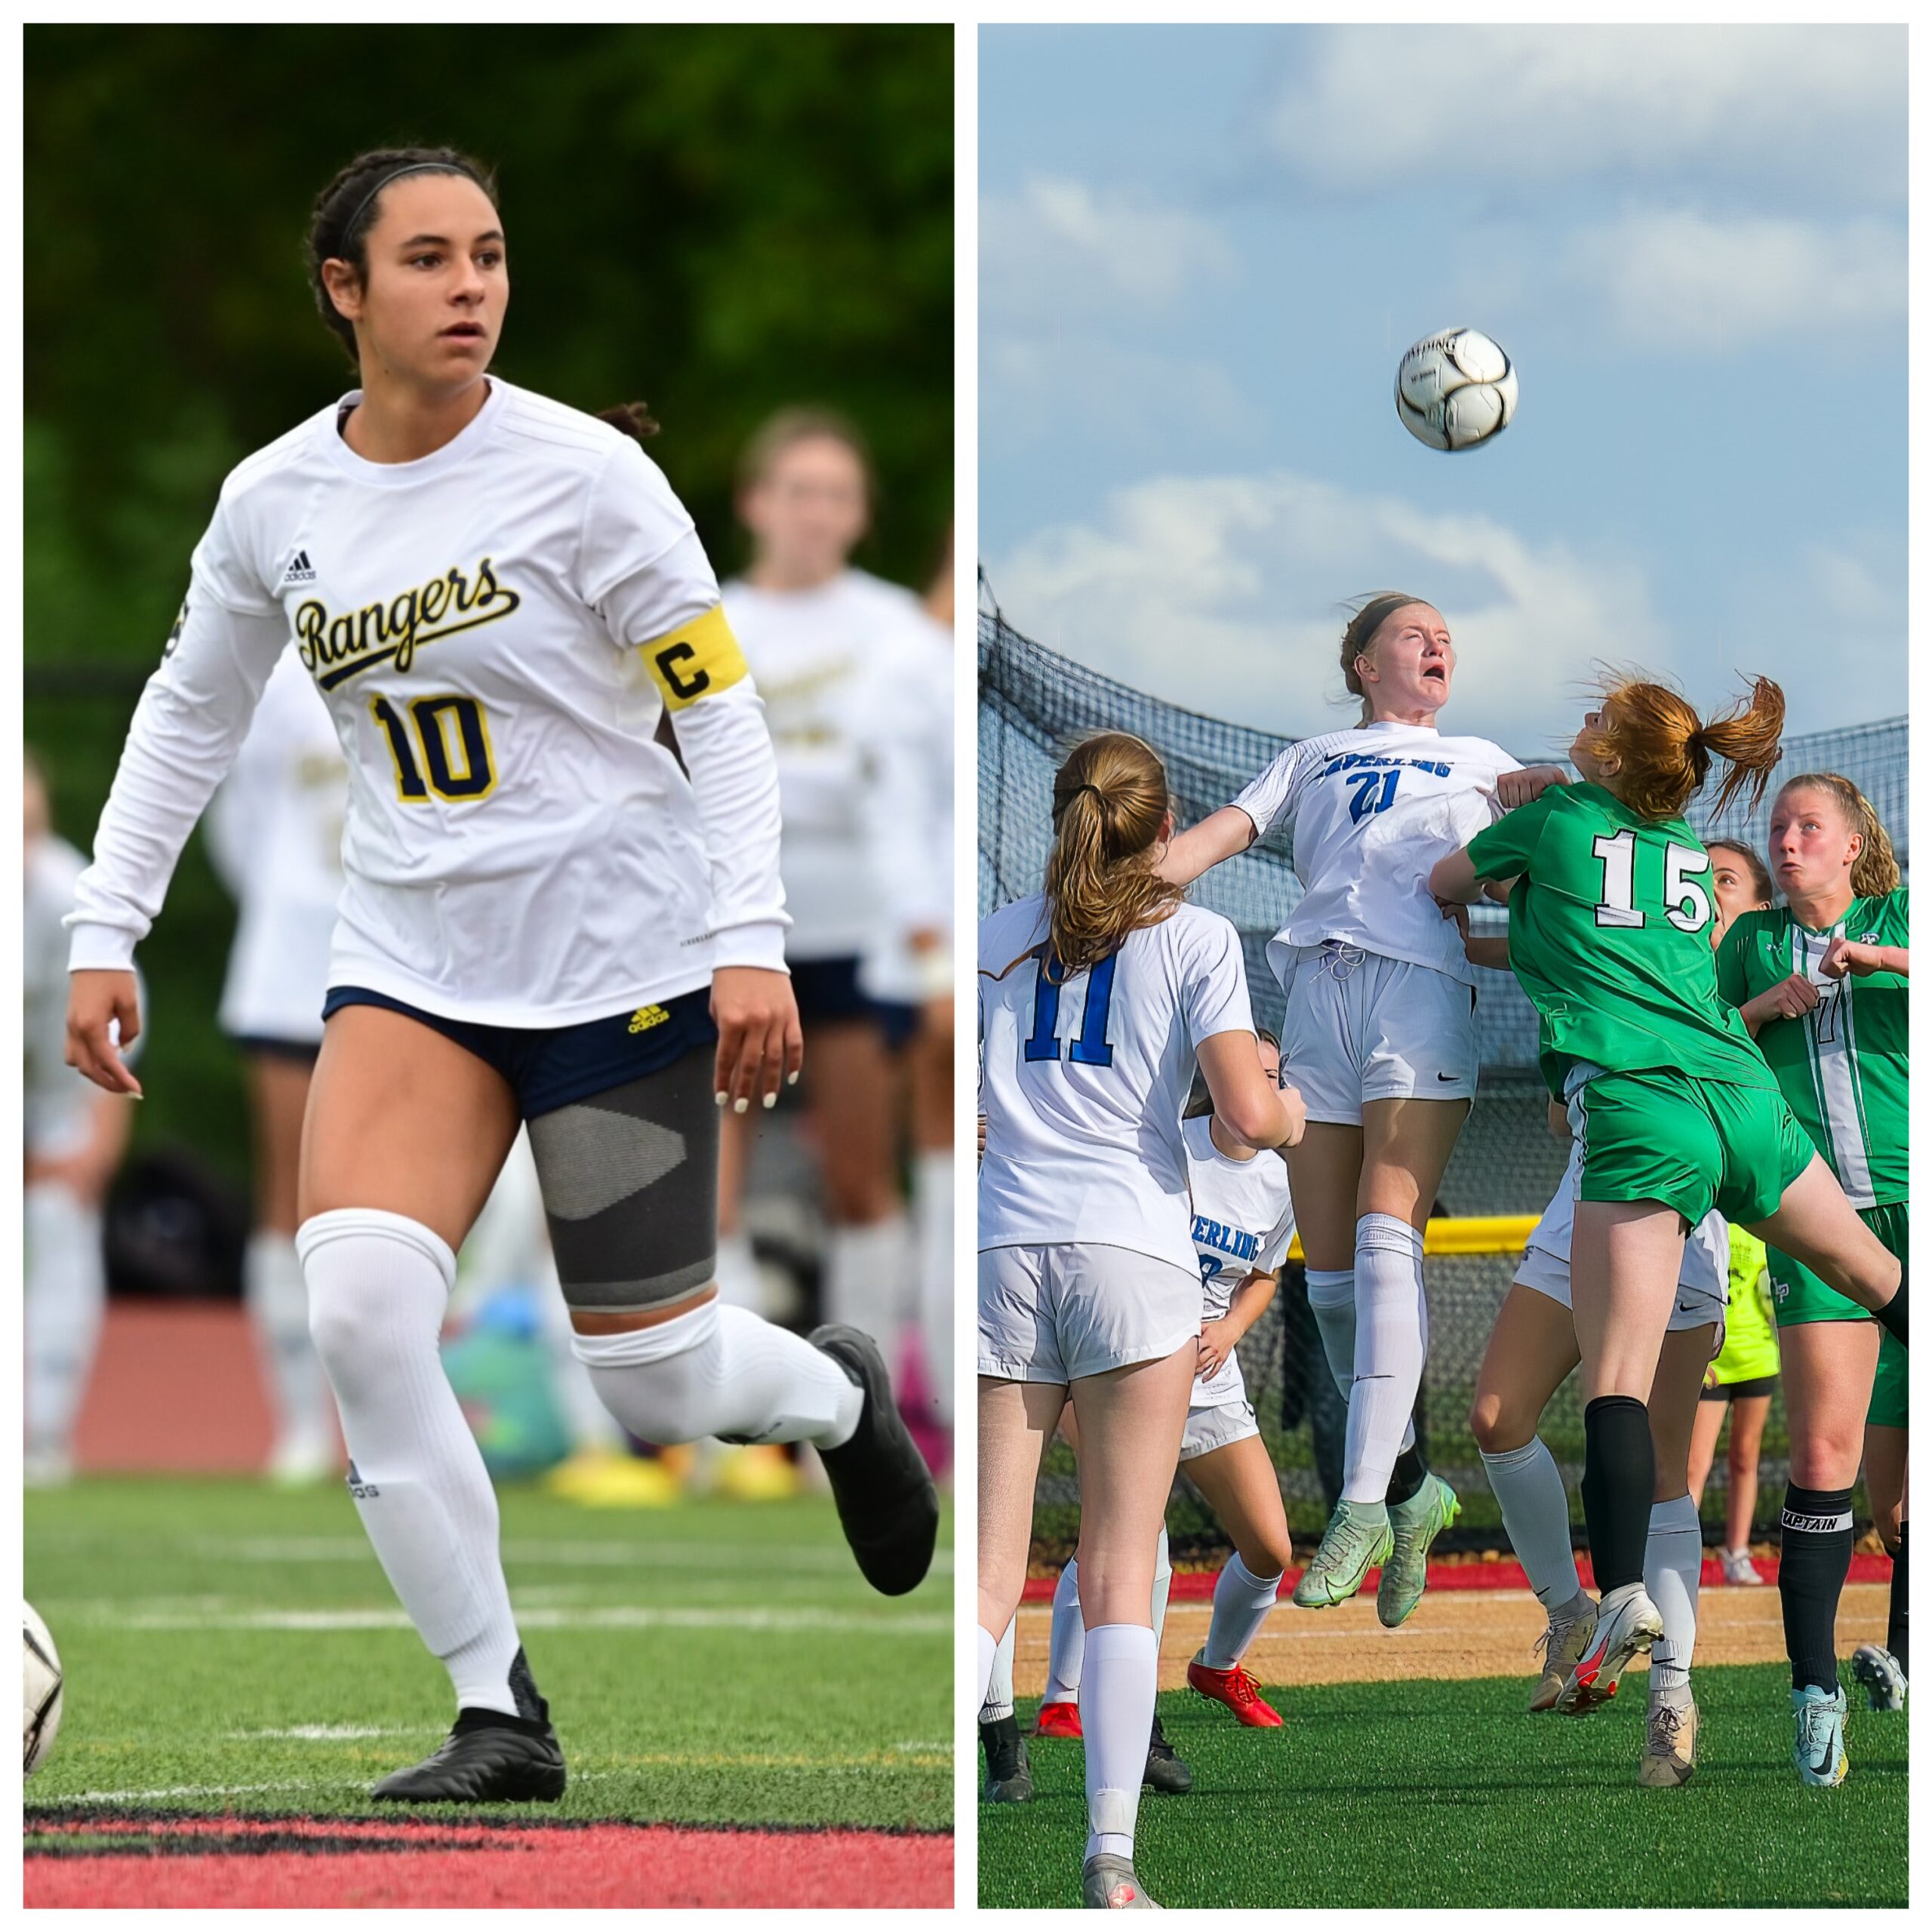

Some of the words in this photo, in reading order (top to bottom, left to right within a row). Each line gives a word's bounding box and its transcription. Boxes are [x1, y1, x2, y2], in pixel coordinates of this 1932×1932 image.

[285, 571, 315, 582] adidas
[296, 557, 521, 691] Rangers
[655, 641, 710, 699] C
[367, 692, 499, 803] 10
[1346, 770, 1401, 826] 21
[1592, 828, 1712, 934] 15
[628, 1010, 670, 1034] adidas
[1024, 946, 1119, 1068] 11
